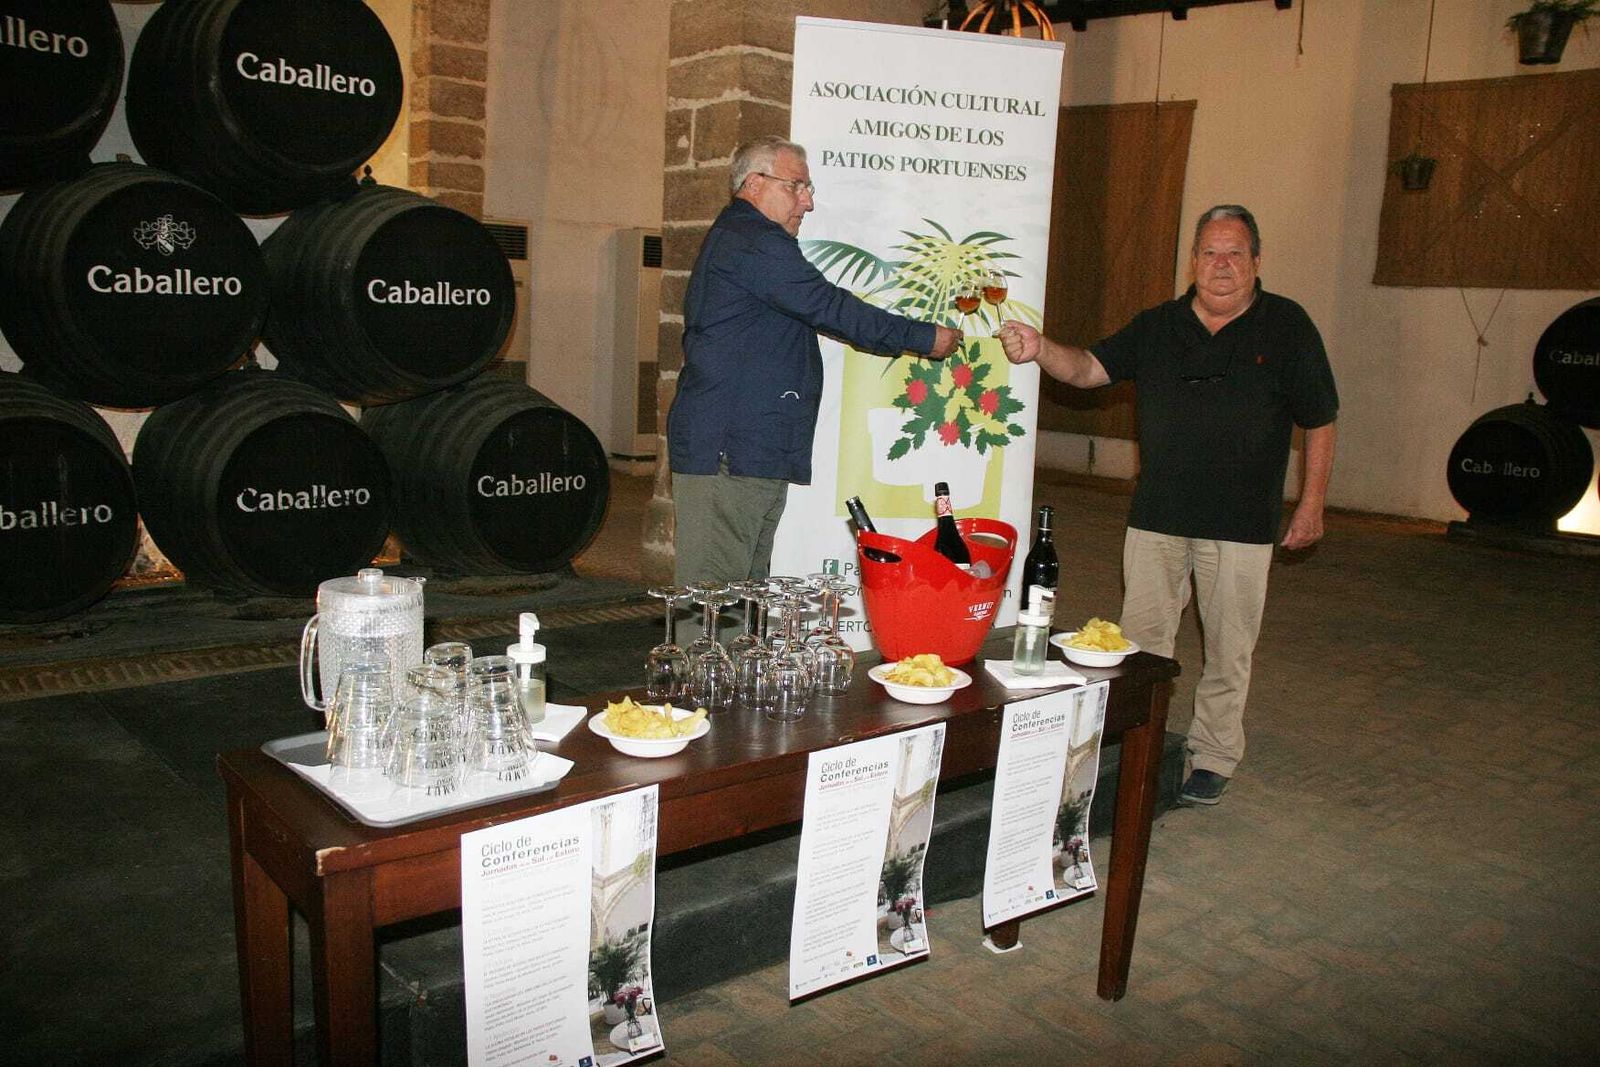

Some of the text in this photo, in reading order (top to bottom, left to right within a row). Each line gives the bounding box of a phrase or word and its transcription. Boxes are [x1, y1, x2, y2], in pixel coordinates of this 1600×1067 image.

[0, 15, 88, 57] llero
[236, 52, 376, 97] Caballero
[809, 81, 1046, 117] ASOCIACIÓN CULTURAL
[849, 118, 1005, 146] AMIGOS DE LOS
[821, 150, 1028, 182] PATIOS PORTUENSES
[87, 264, 242, 296] Caballero
[367, 278, 491, 306] Caballero
[1461, 457, 1541, 479] Cabllero
[237, 484, 371, 513] Caballero
[477, 471, 586, 498] Caballero
[0, 501, 113, 530] ballero
[820, 760, 889, 783] Conferencias
[821, 756, 857, 774] Ciclo de
[481, 836, 532, 858] Ciclo de
[481, 836, 580, 868] Conferencias
